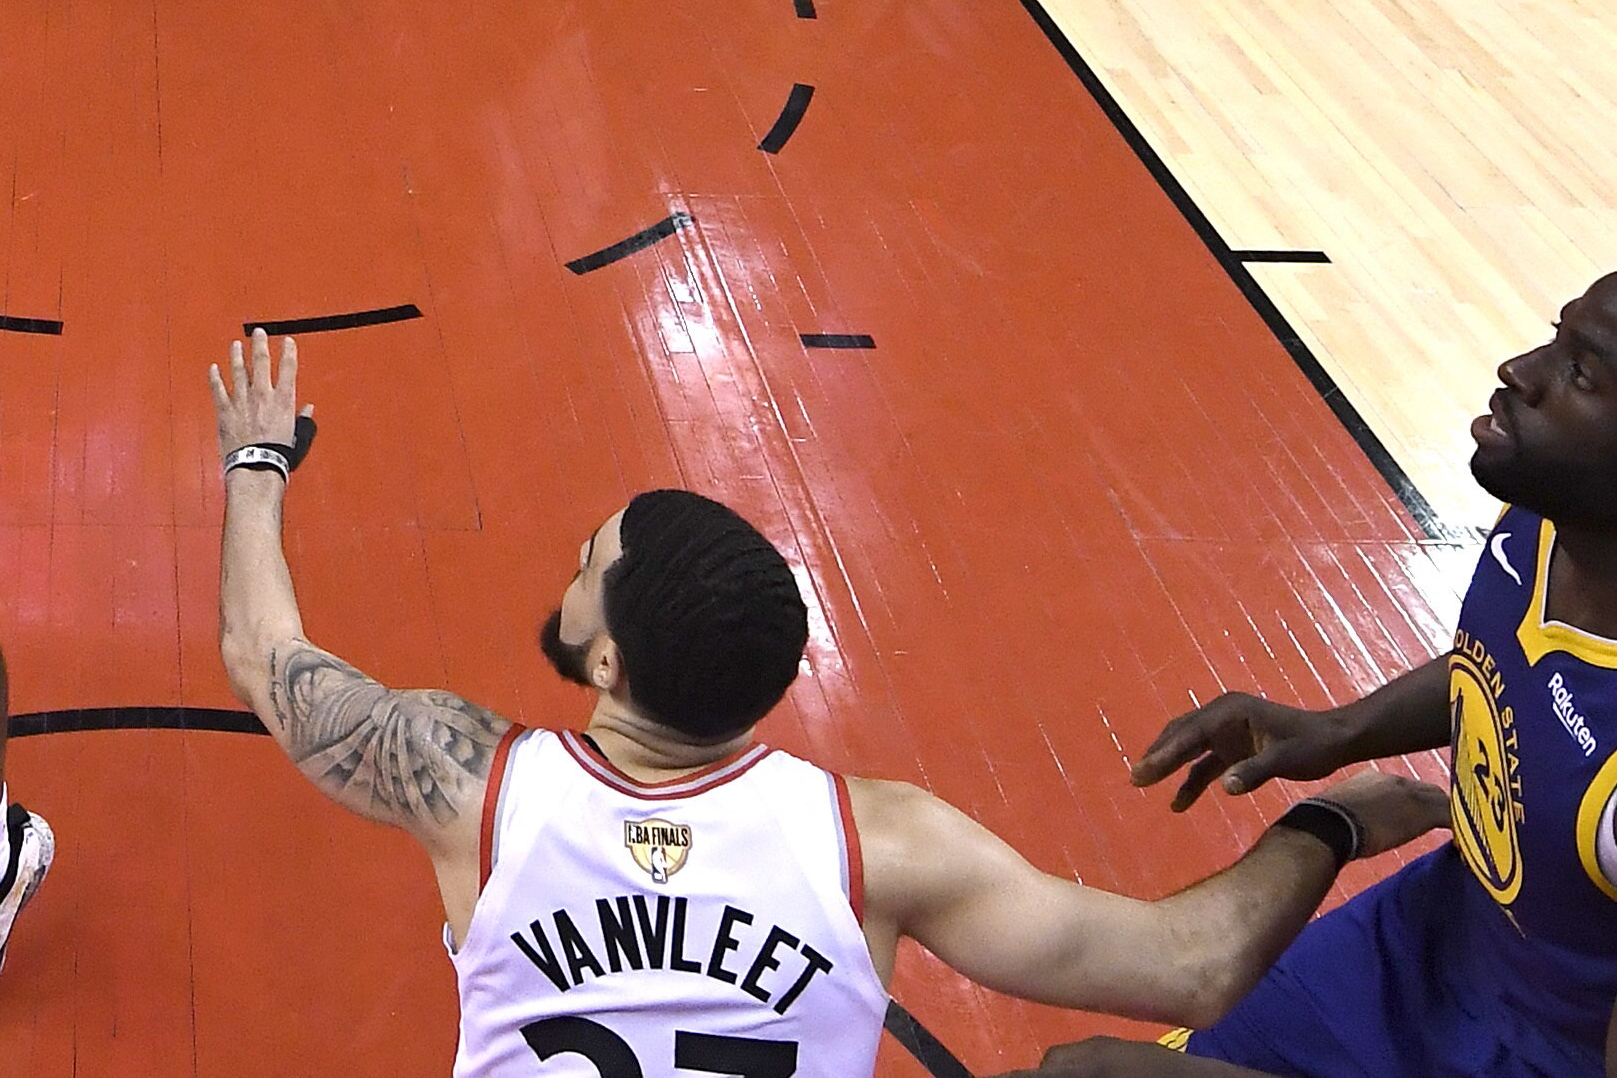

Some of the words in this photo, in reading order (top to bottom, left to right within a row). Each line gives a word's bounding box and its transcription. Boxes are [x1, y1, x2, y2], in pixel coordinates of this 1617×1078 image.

[1454, 628, 1506, 698] OLDEN
[1500, 705, 1526, 824] STATE
[1547, 672, 1597, 757] Rakuten
[1473, 737, 1506, 834] 23
[651, 826, 689, 848] FINALS
[510, 895, 834, 1015] VANVLEET
